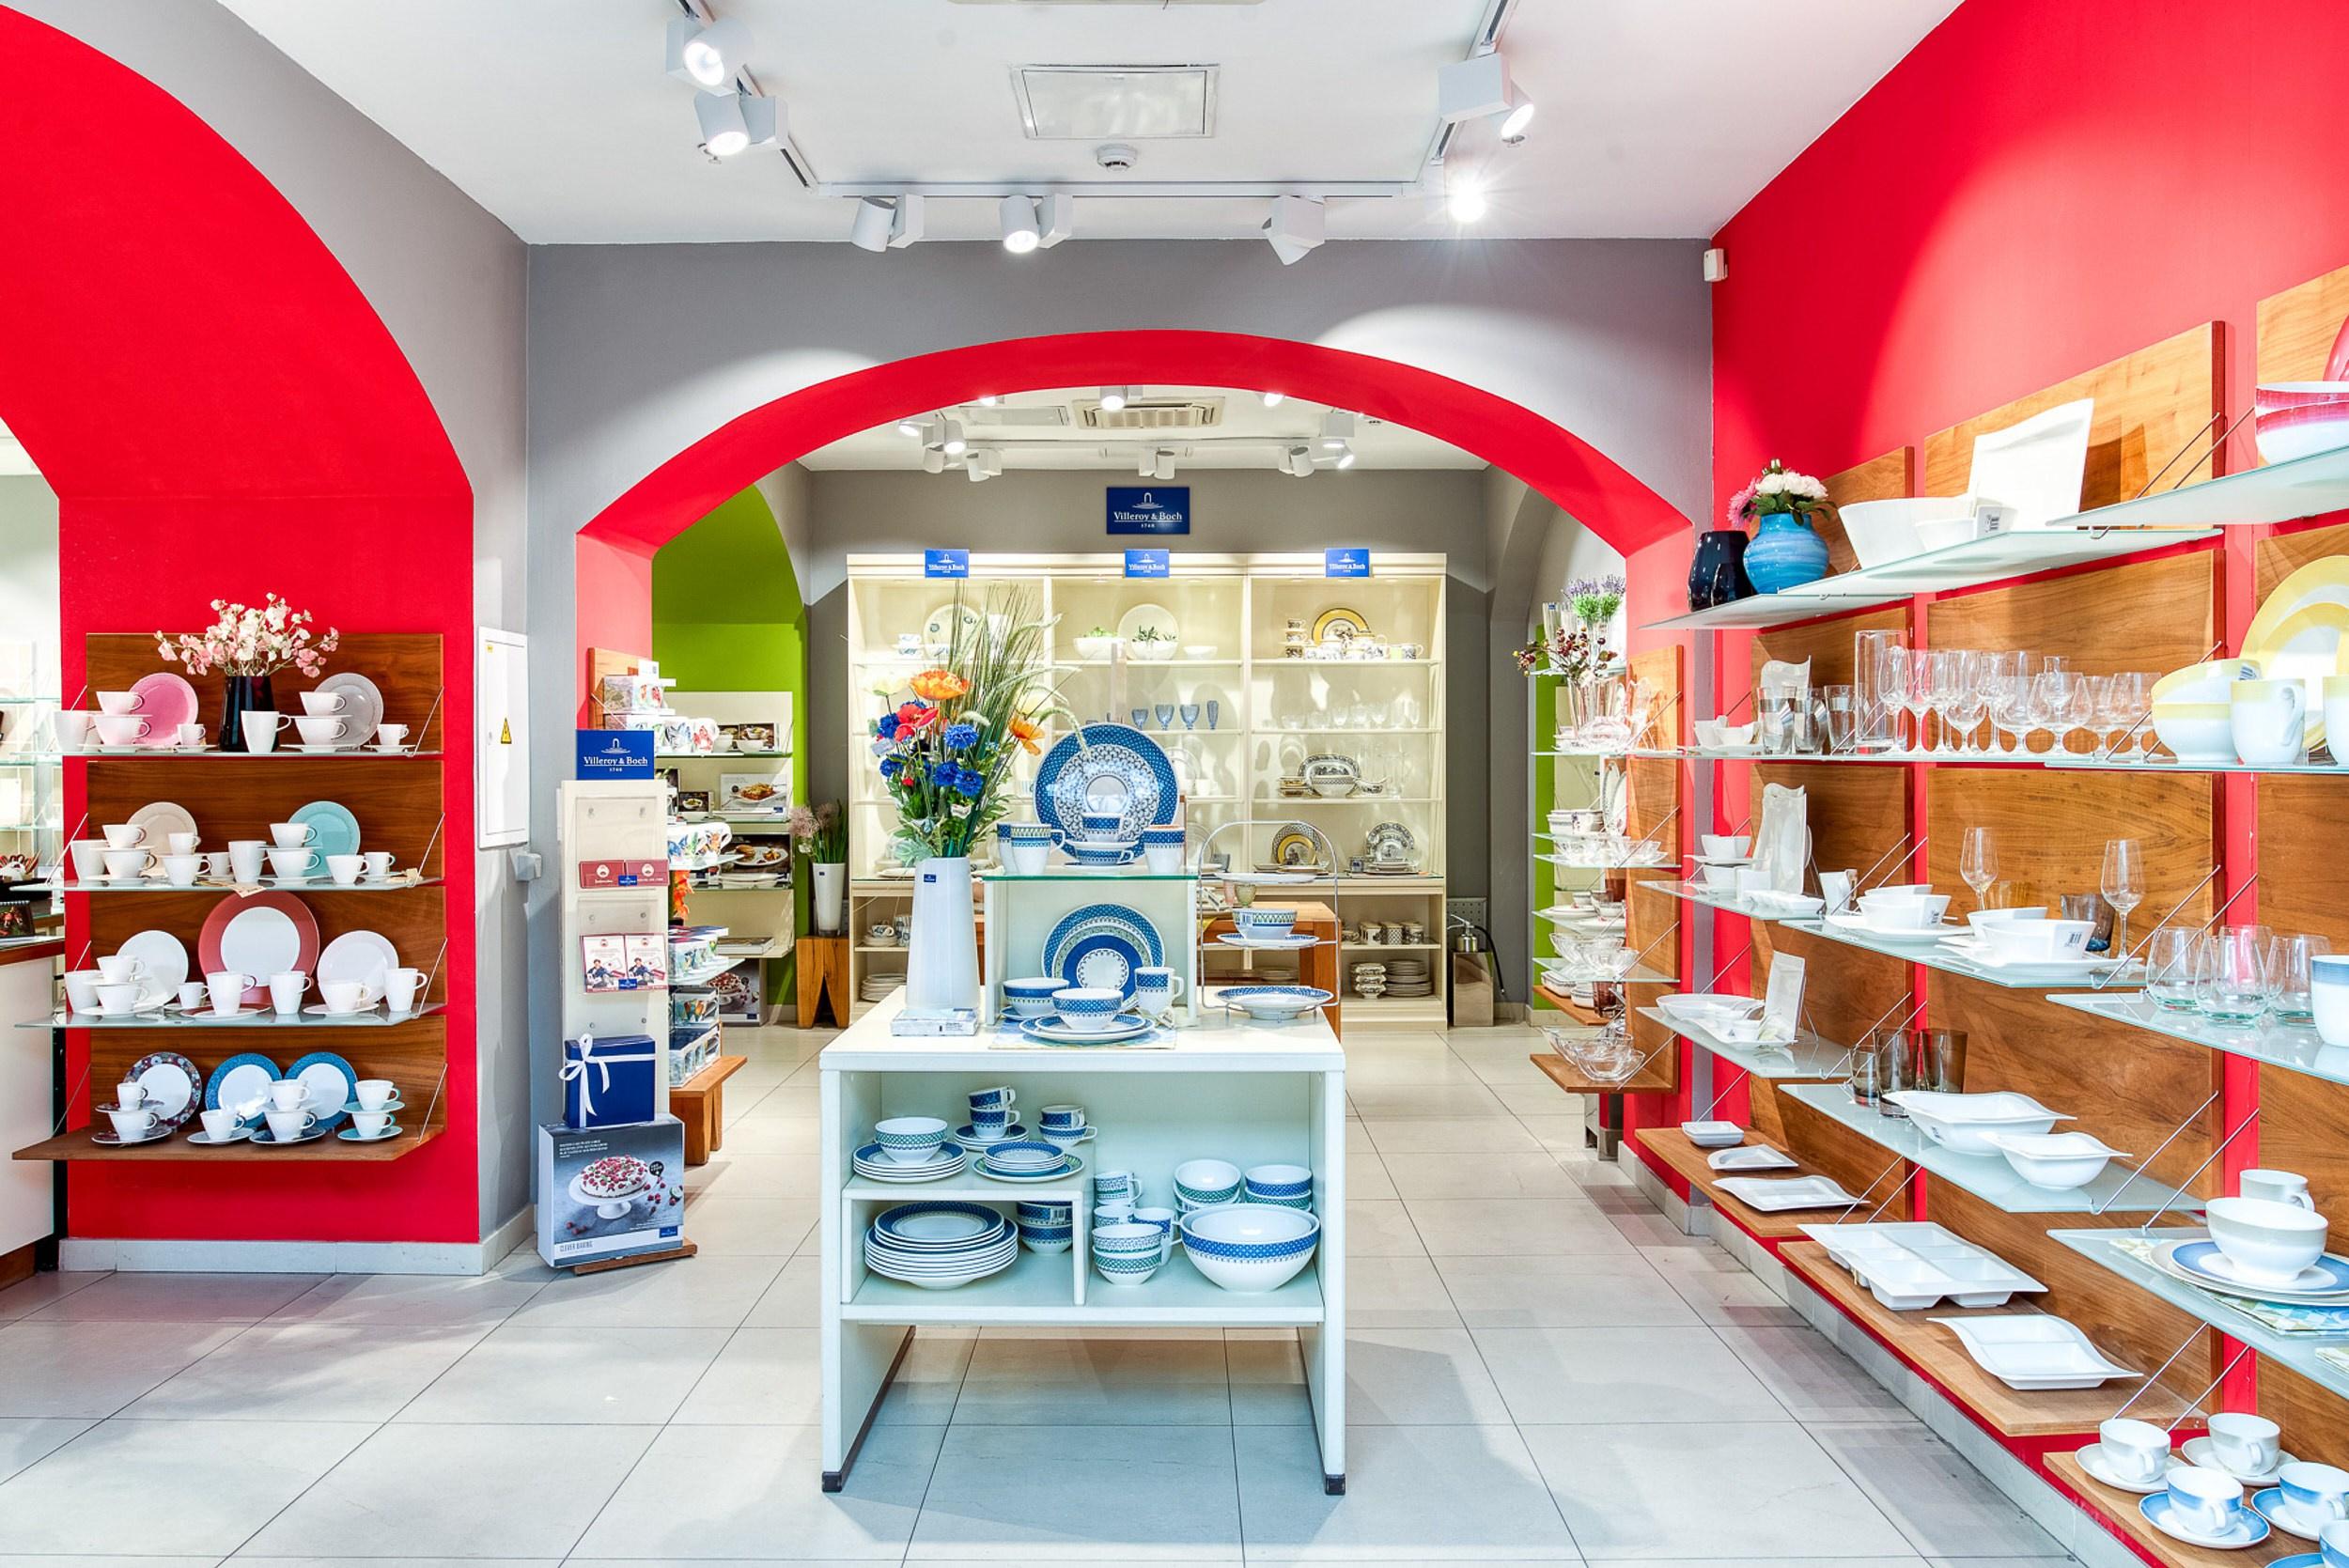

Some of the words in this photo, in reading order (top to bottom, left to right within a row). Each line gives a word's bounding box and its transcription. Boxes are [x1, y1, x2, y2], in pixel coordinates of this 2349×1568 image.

[1113, 511, 1149, 521] Villeroy
[1150, 512, 1158, 520] &
[1159, 511, 1183, 520] Boch
[583, 756, 617, 766] Villeroy
[626, 756, 648, 765] Boch
